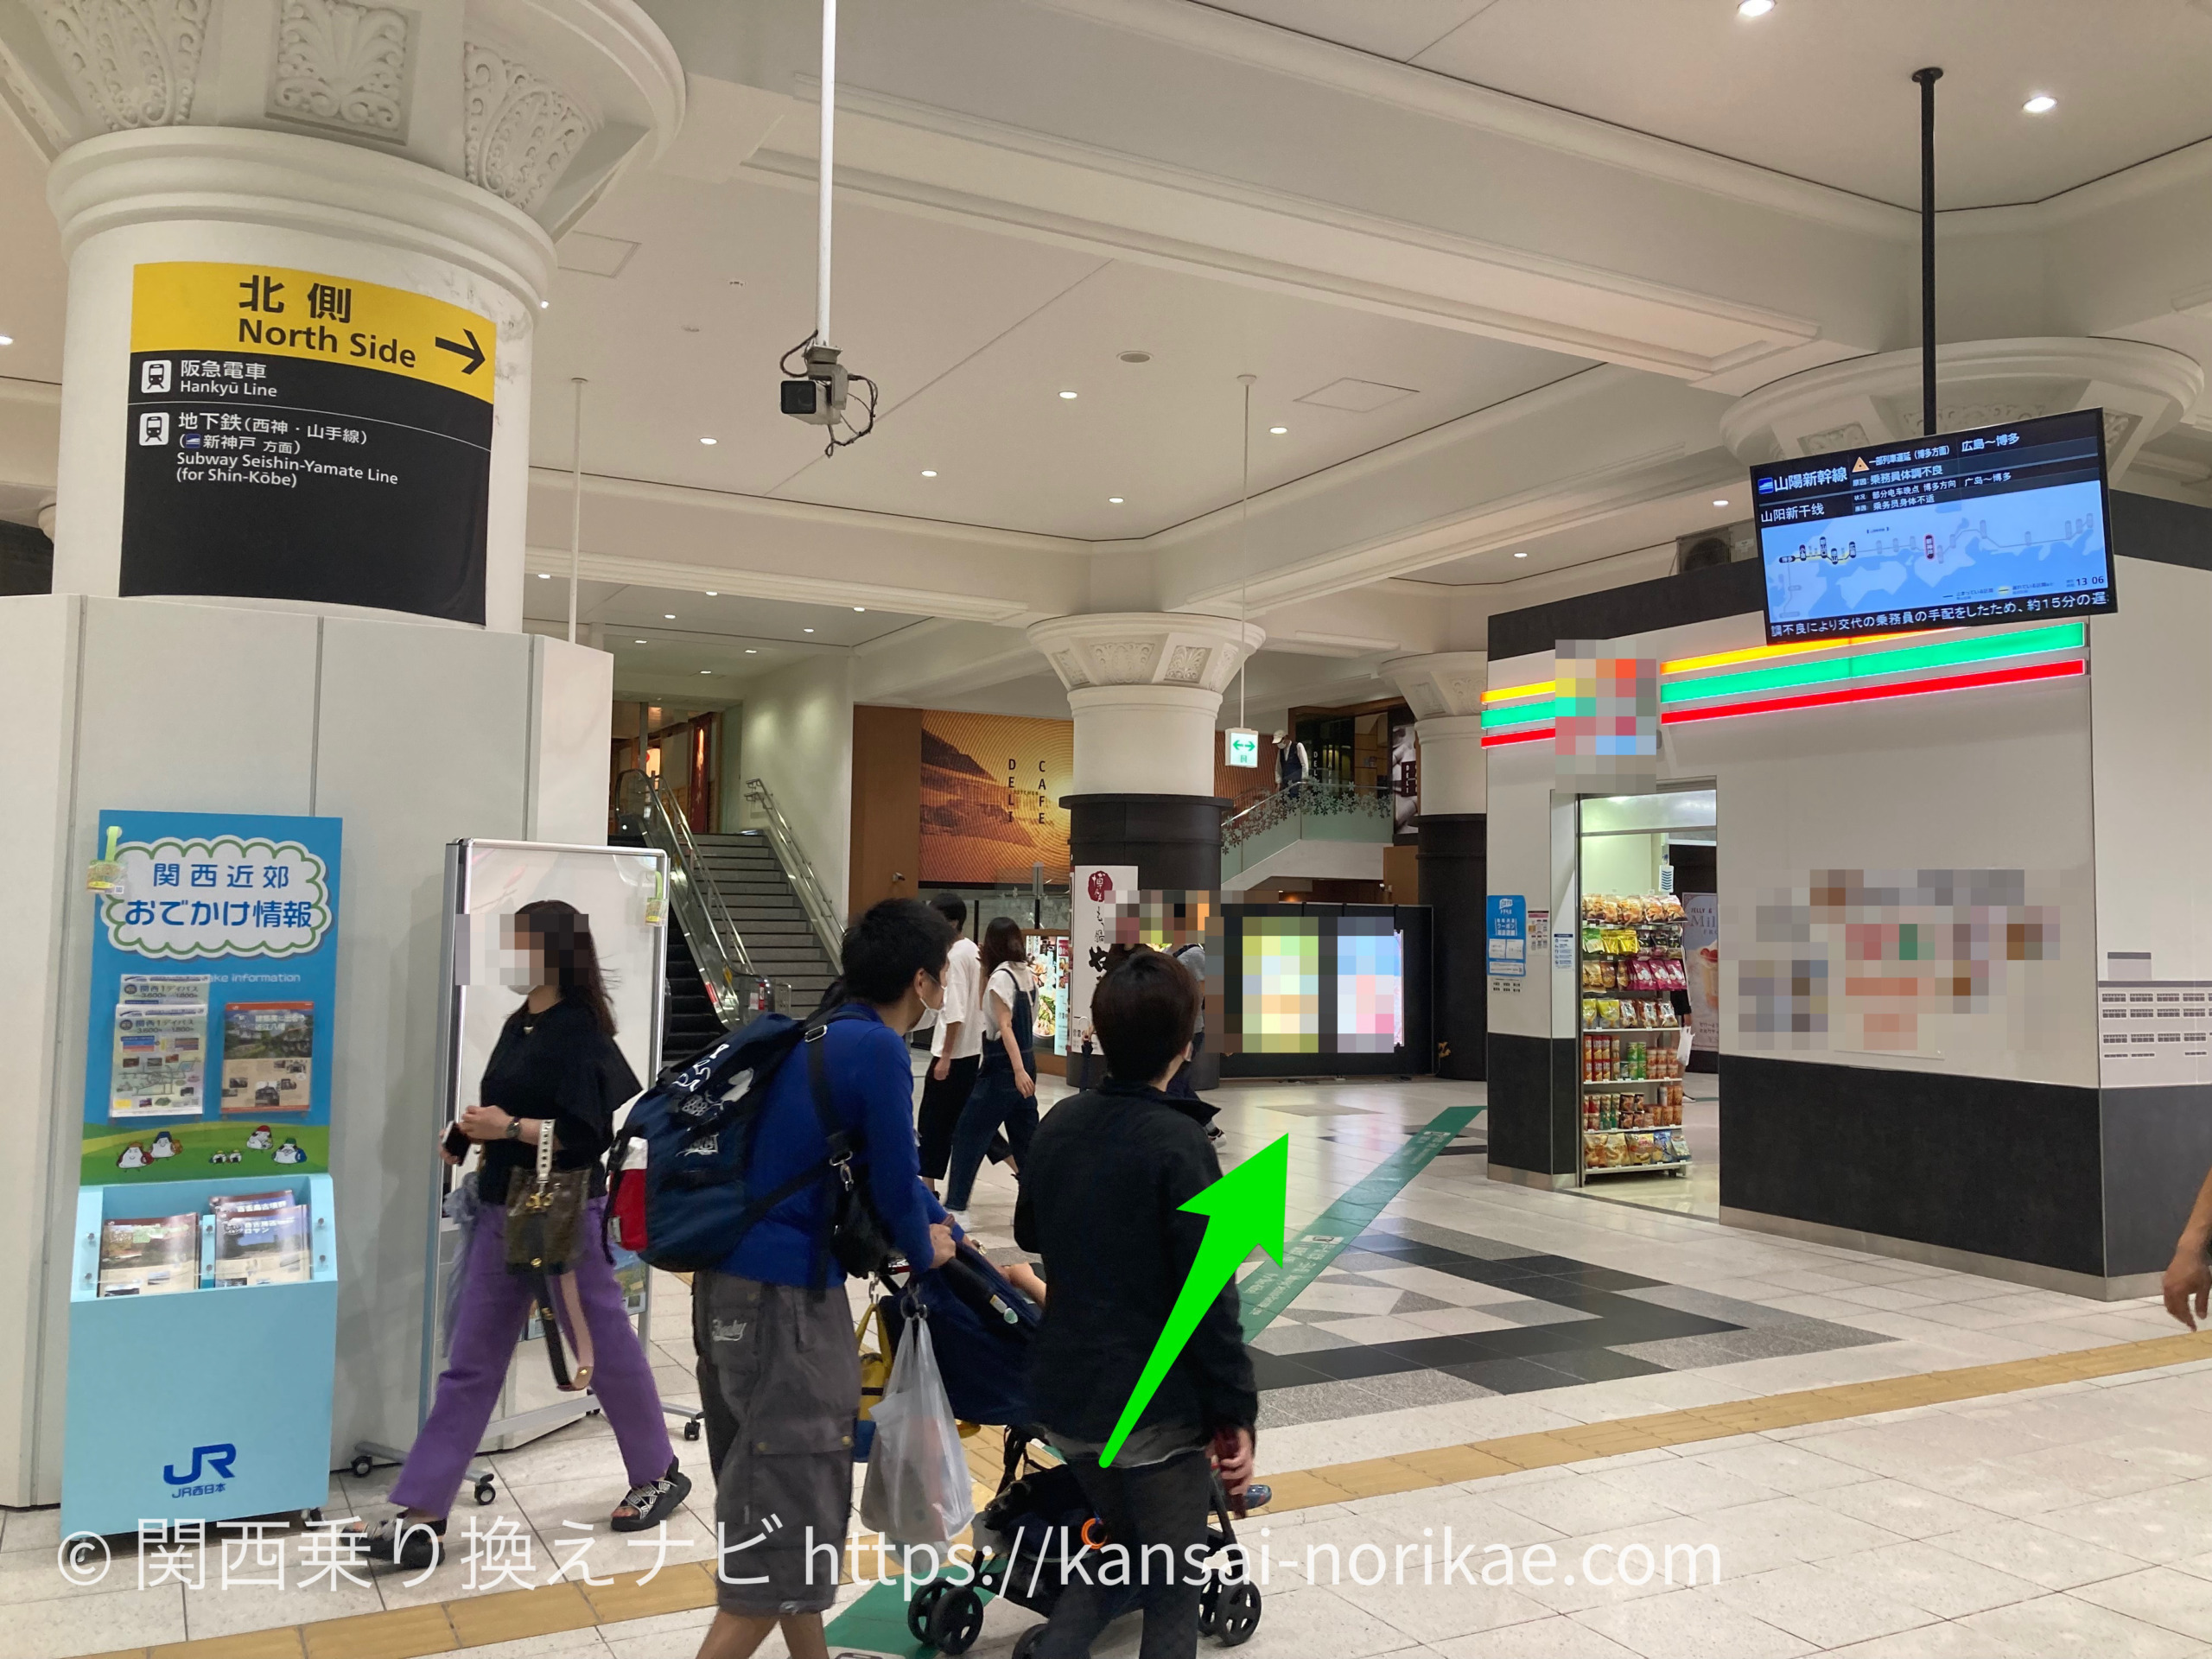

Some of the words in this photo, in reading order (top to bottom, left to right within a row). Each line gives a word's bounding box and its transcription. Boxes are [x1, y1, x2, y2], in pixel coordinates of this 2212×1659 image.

[238, 275, 352, 324] 北側
[238, 318, 338, 353] North
[349, 333, 416, 369] Side
[180, 359, 267, 379] 阪急電車
[180, 380, 239, 397] Hankyū
[244, 382, 277, 397] Line
[176, 467, 205, 483] (for
[177, 452, 238, 468] Subway
[242, 454, 364, 480] Seishin-Yamate
[367, 468, 398, 485] Line
[1774, 467, 1848, 493] 山陽新幹線
[1760, 503, 1825, 523] 山阳新干线
[1771, 591, 2110, 637] 調不良により交代の乗務員の手配をしたため、約15分の遅
[152, 862, 289, 890] 関西近郊
[125, 899, 313, 929] おでかけ情報
[232, 974, 301, 982] information
[163, 1443, 237, 1485] JR
[172, 1483, 226, 1498] JR西日本
